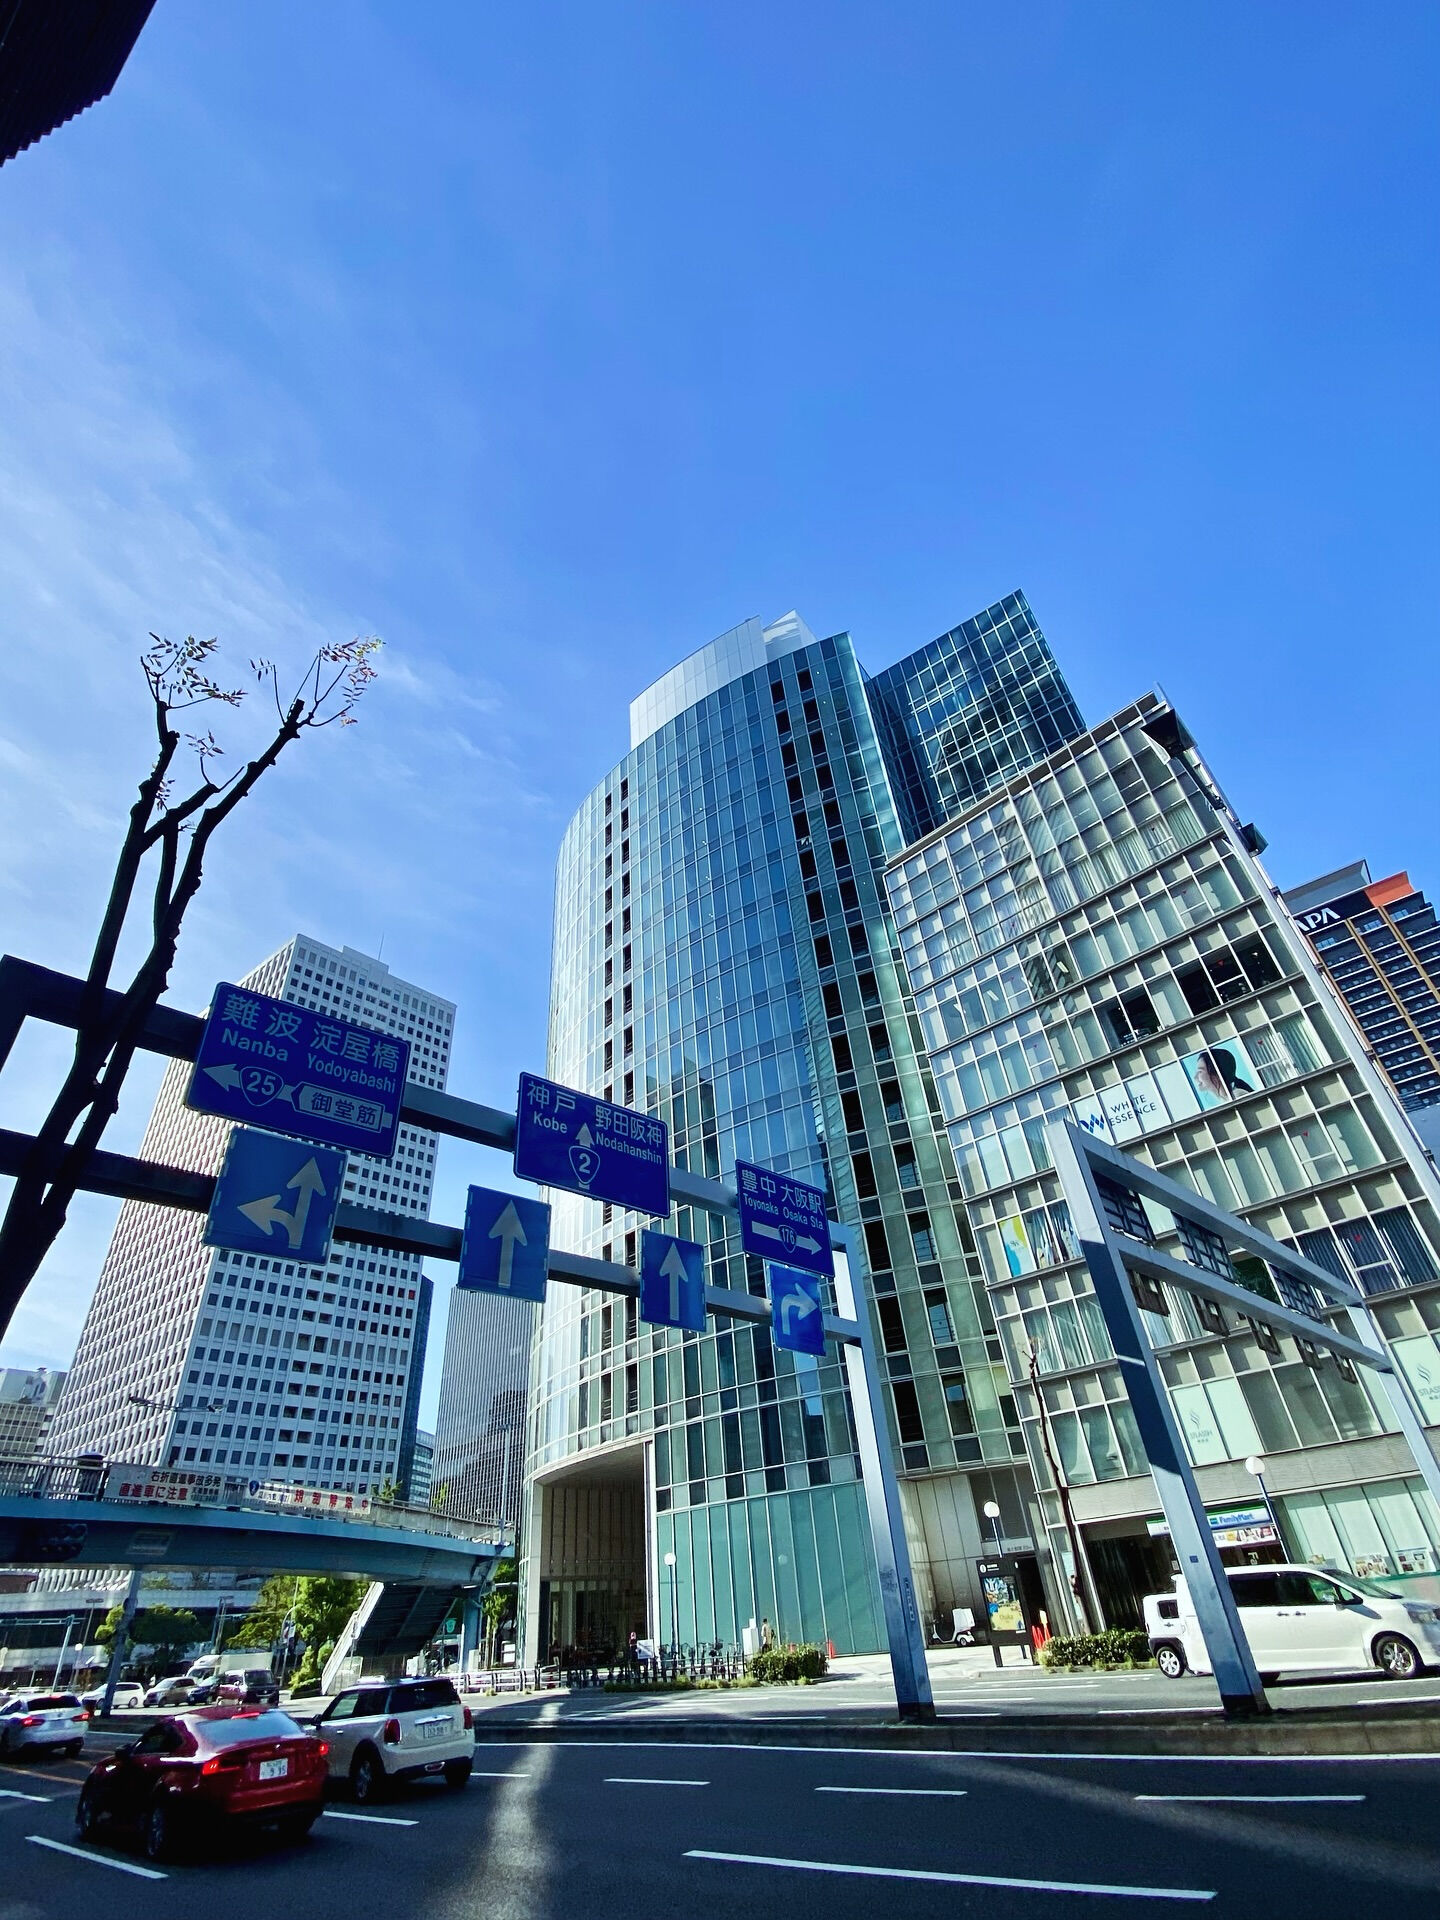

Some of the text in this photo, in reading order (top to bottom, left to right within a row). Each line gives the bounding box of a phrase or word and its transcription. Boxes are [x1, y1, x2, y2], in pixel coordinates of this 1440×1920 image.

[222, 993, 400, 1073] 難波 淀屋橋
[221, 1028, 396, 1093] Nanba Yodoyabashi
[246, 1071, 276, 1096] 25
[310, 1092, 378, 1126] 御堂筋
[527, 1081, 662, 1148] 神戸 野田阪神
[533, 1110, 662, 1165] Kobe Nodahanshin
[578, 1153, 591, 1174] 2
[742, 1169, 824, 1216] 豊中 大阪駅
[742, 1193, 779, 1215] Toyonaka
[783, 1207, 808, 1225] Osaka
[782, 1228, 795, 1245] 176
[119, 1483, 189, 1501] 直進車に注意
[1219, 1513, 1254, 1524] FamilyMart
